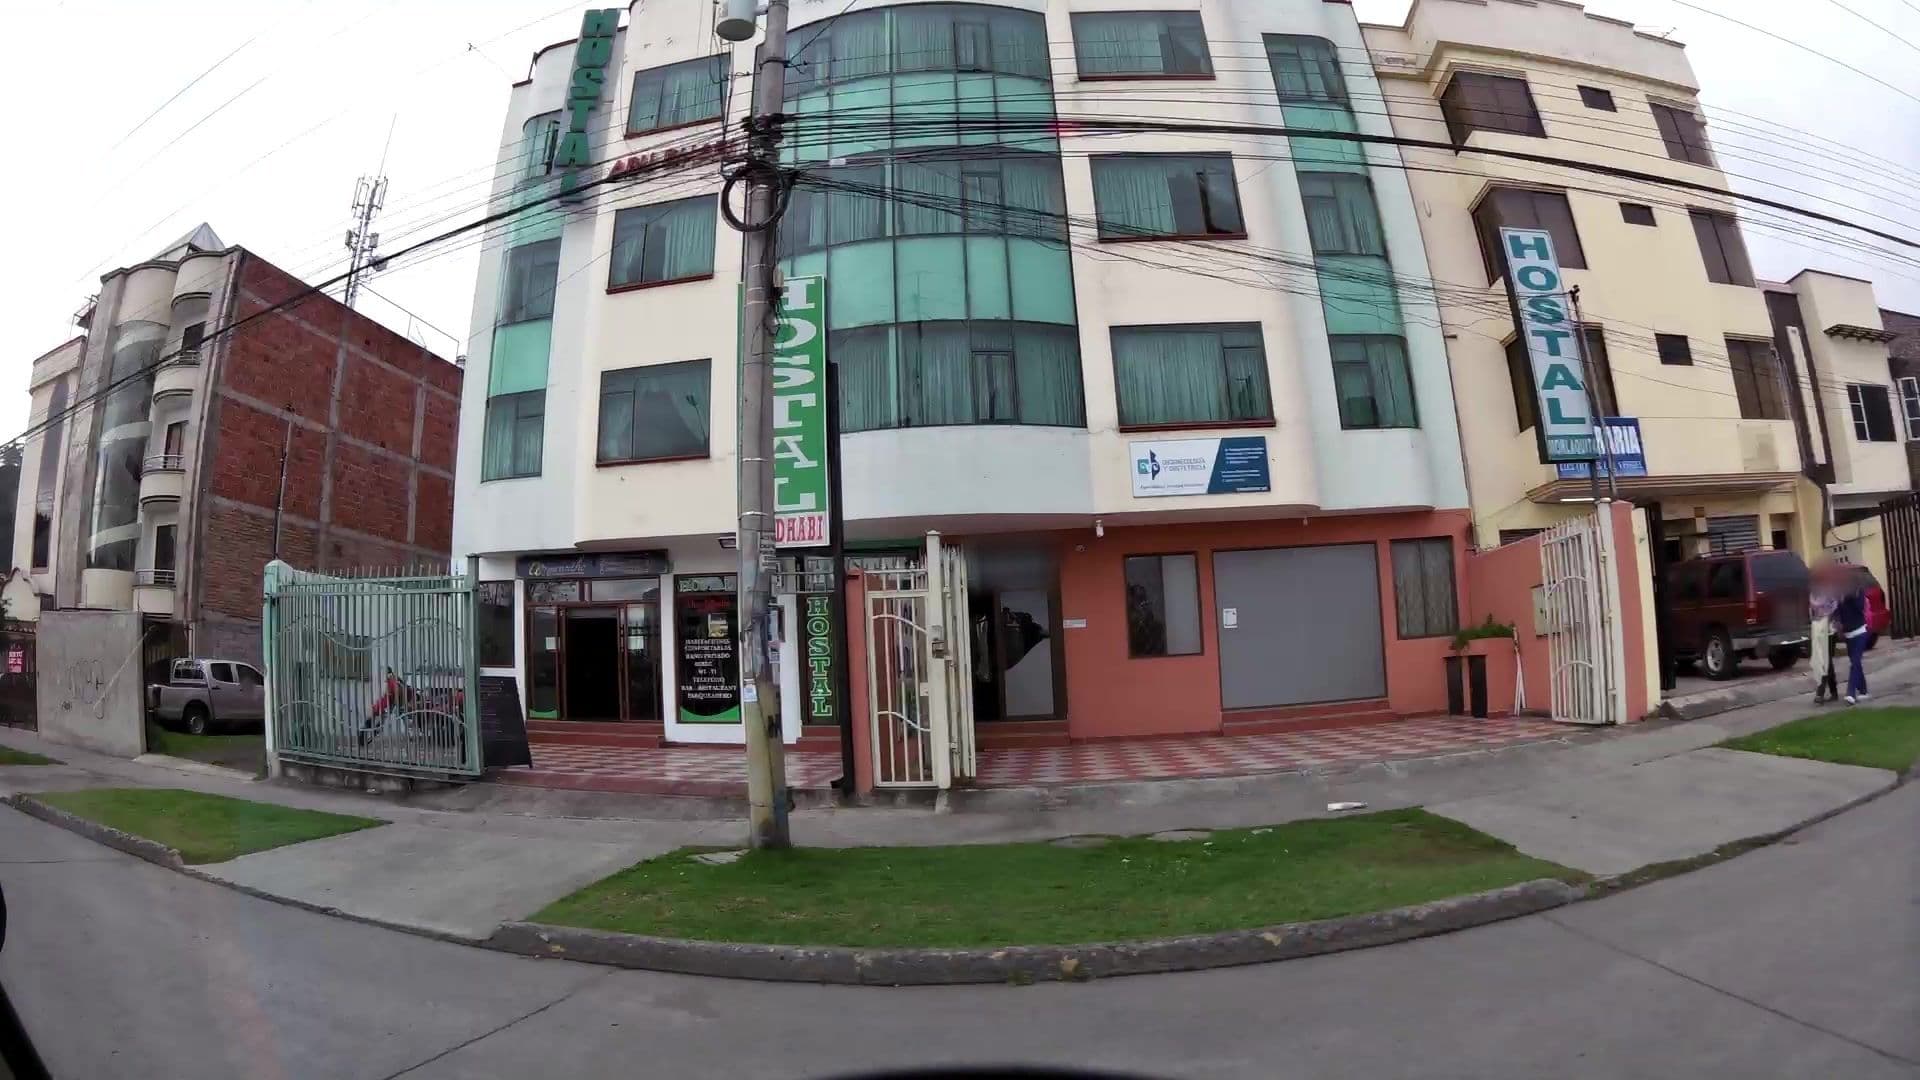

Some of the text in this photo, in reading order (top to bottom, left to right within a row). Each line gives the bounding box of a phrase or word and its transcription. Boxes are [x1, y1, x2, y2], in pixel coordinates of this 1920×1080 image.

[554, 8, 621, 204] HOSTAL
[1509, 235, 1585, 424] HOSTAL
[775, 515, 824, 542] DHABI
[807, 596, 833, 717] HOSTAL
